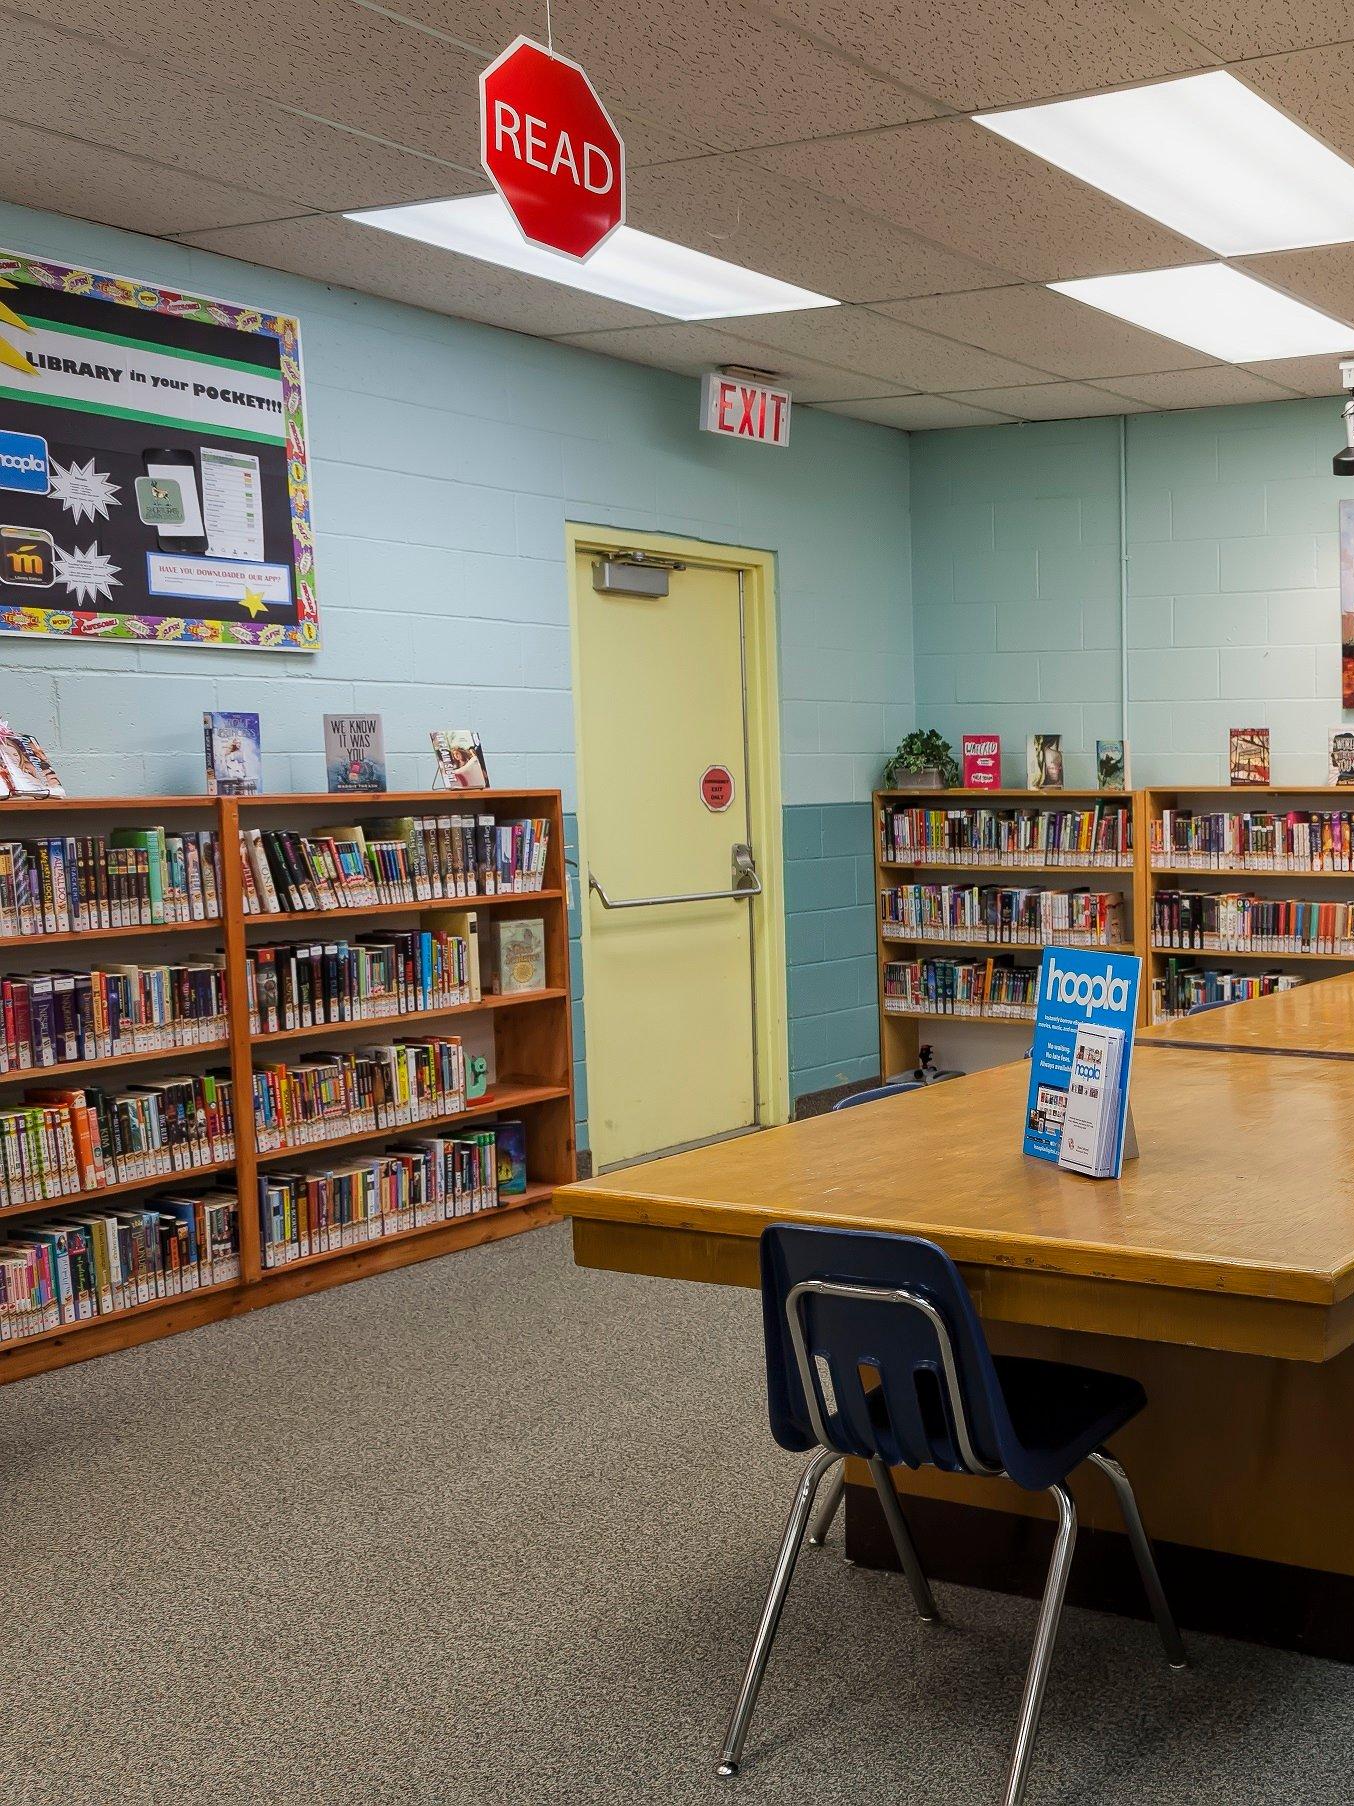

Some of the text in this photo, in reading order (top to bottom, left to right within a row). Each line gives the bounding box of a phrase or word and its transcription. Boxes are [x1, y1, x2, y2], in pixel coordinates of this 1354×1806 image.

[494, 100, 614, 195] READ
[26, 351, 282, 414] LIBRARY in your POCKET!!!
[718, 382, 786, 442] EXIT
[159, 565, 178, 574] HAVE
[180, 567, 195, 575] YOU
[196, 569, 246, 580] DOWNLOADED
[248, 573, 263, 582] OUR
[264, 575, 281, 583] APP?
[82, 618, 117, 631] AWESOME!
[331, 720, 376, 734] WE KNOW
[339, 734, 370, 748] IT WAS
[346, 748, 364, 762] YOU
[419, 856, 428, 875] Ashe
[432, 854, 440, 873] Glass
[446, 853, 454, 873] Glass
[1047, 957, 1129, 1018] hoopla
[39, 1004, 50, 1036] INKSPEL
[1051, 1052, 1060, 1060] late
[1040, 1060, 1072, 1072] Always availabl
[1075, 1063, 1100, 1081] hoopla
[100, 1127, 109, 1148] KIM
[159, 1114, 168, 1143] BIG RED
